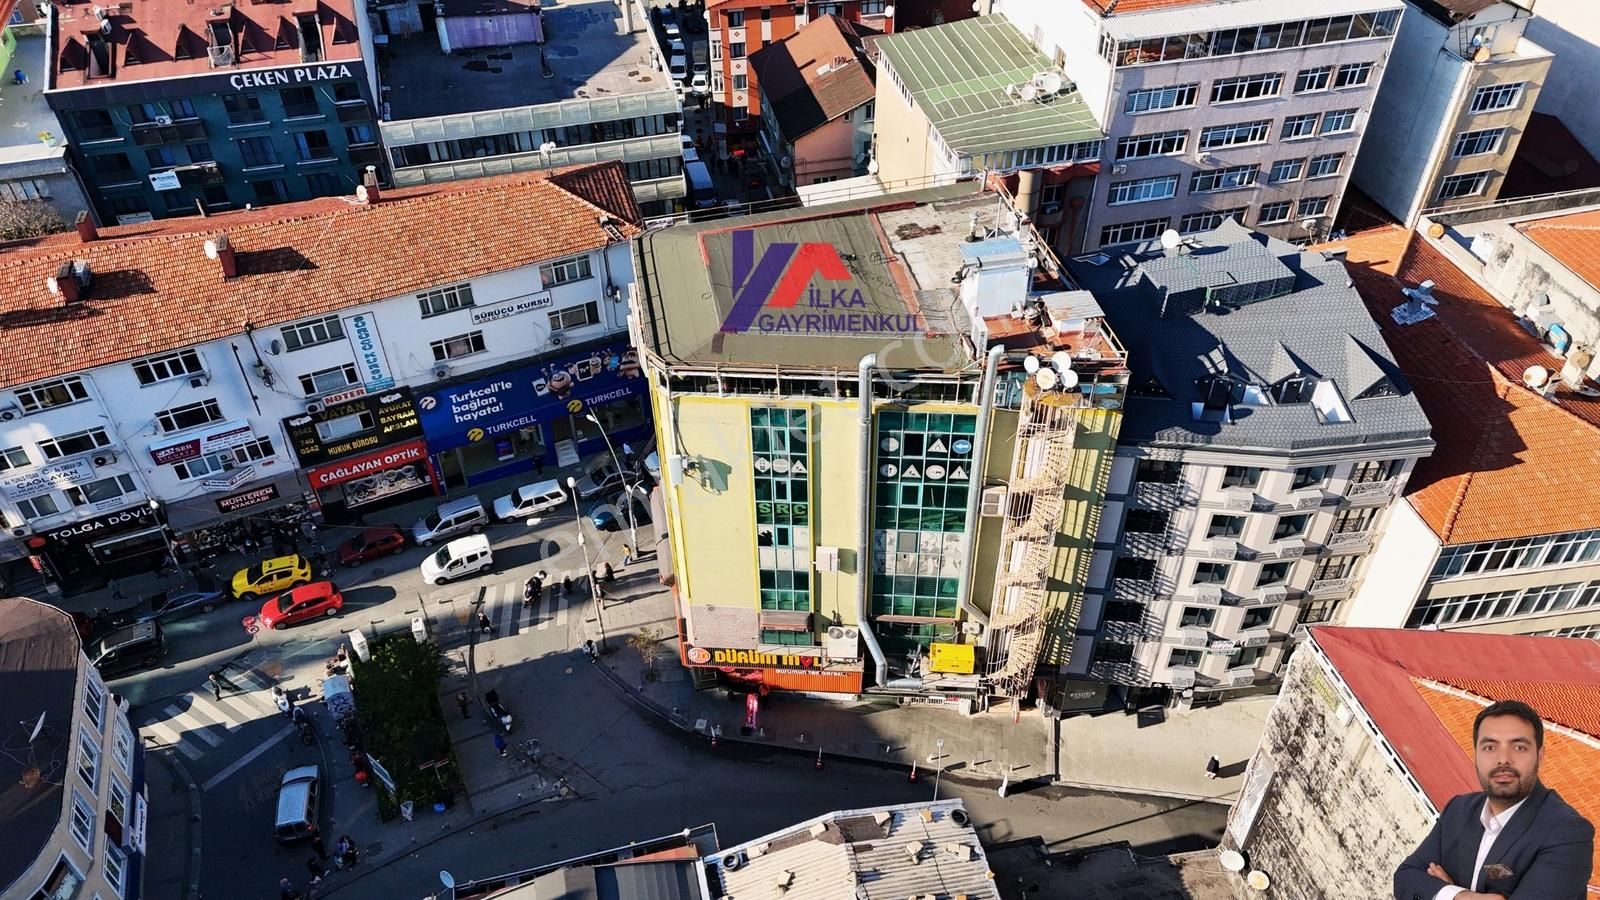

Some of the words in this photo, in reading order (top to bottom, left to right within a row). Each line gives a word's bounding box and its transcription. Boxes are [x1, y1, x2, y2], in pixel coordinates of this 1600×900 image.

[230, 70, 289, 90] ÇEKEN
[294, 64, 352, 82] PLAZA
[474, 305, 514, 320] SÜRÜCÜ
[517, 297, 549, 310] KURSU
[325, 387, 365, 405] NOTER
[449, 381, 513, 404] Turkcell'le
[585, 387, 632, 406] TURKCELL
[319, 401, 367, 420] VATAN
[379, 401, 412, 415] AVUKAT
[451, 396, 497, 414] bağlan
[454, 402, 504, 423] hayata!
[380, 409, 415, 424] BAYRAM
[383, 418, 418, 433] ARSLAN
[486, 415, 537, 434] TURKCELL
[300, 445, 320, 455] 0542
[327, 442, 352, 456] HUKUK
[352, 435, 379, 449] BÜROSU
[320, 460, 382, 483] ÇAĞLAYAN
[384, 447, 420, 464] OPTİK
[221, 486, 273, 508] MUHTEREM
[230, 495, 270, 510] AYAKKABI
[759, 503, 807, 515] SRC
[49, 521, 105, 540] TOLGA
[714, 649, 778, 665] DÜRÜM
